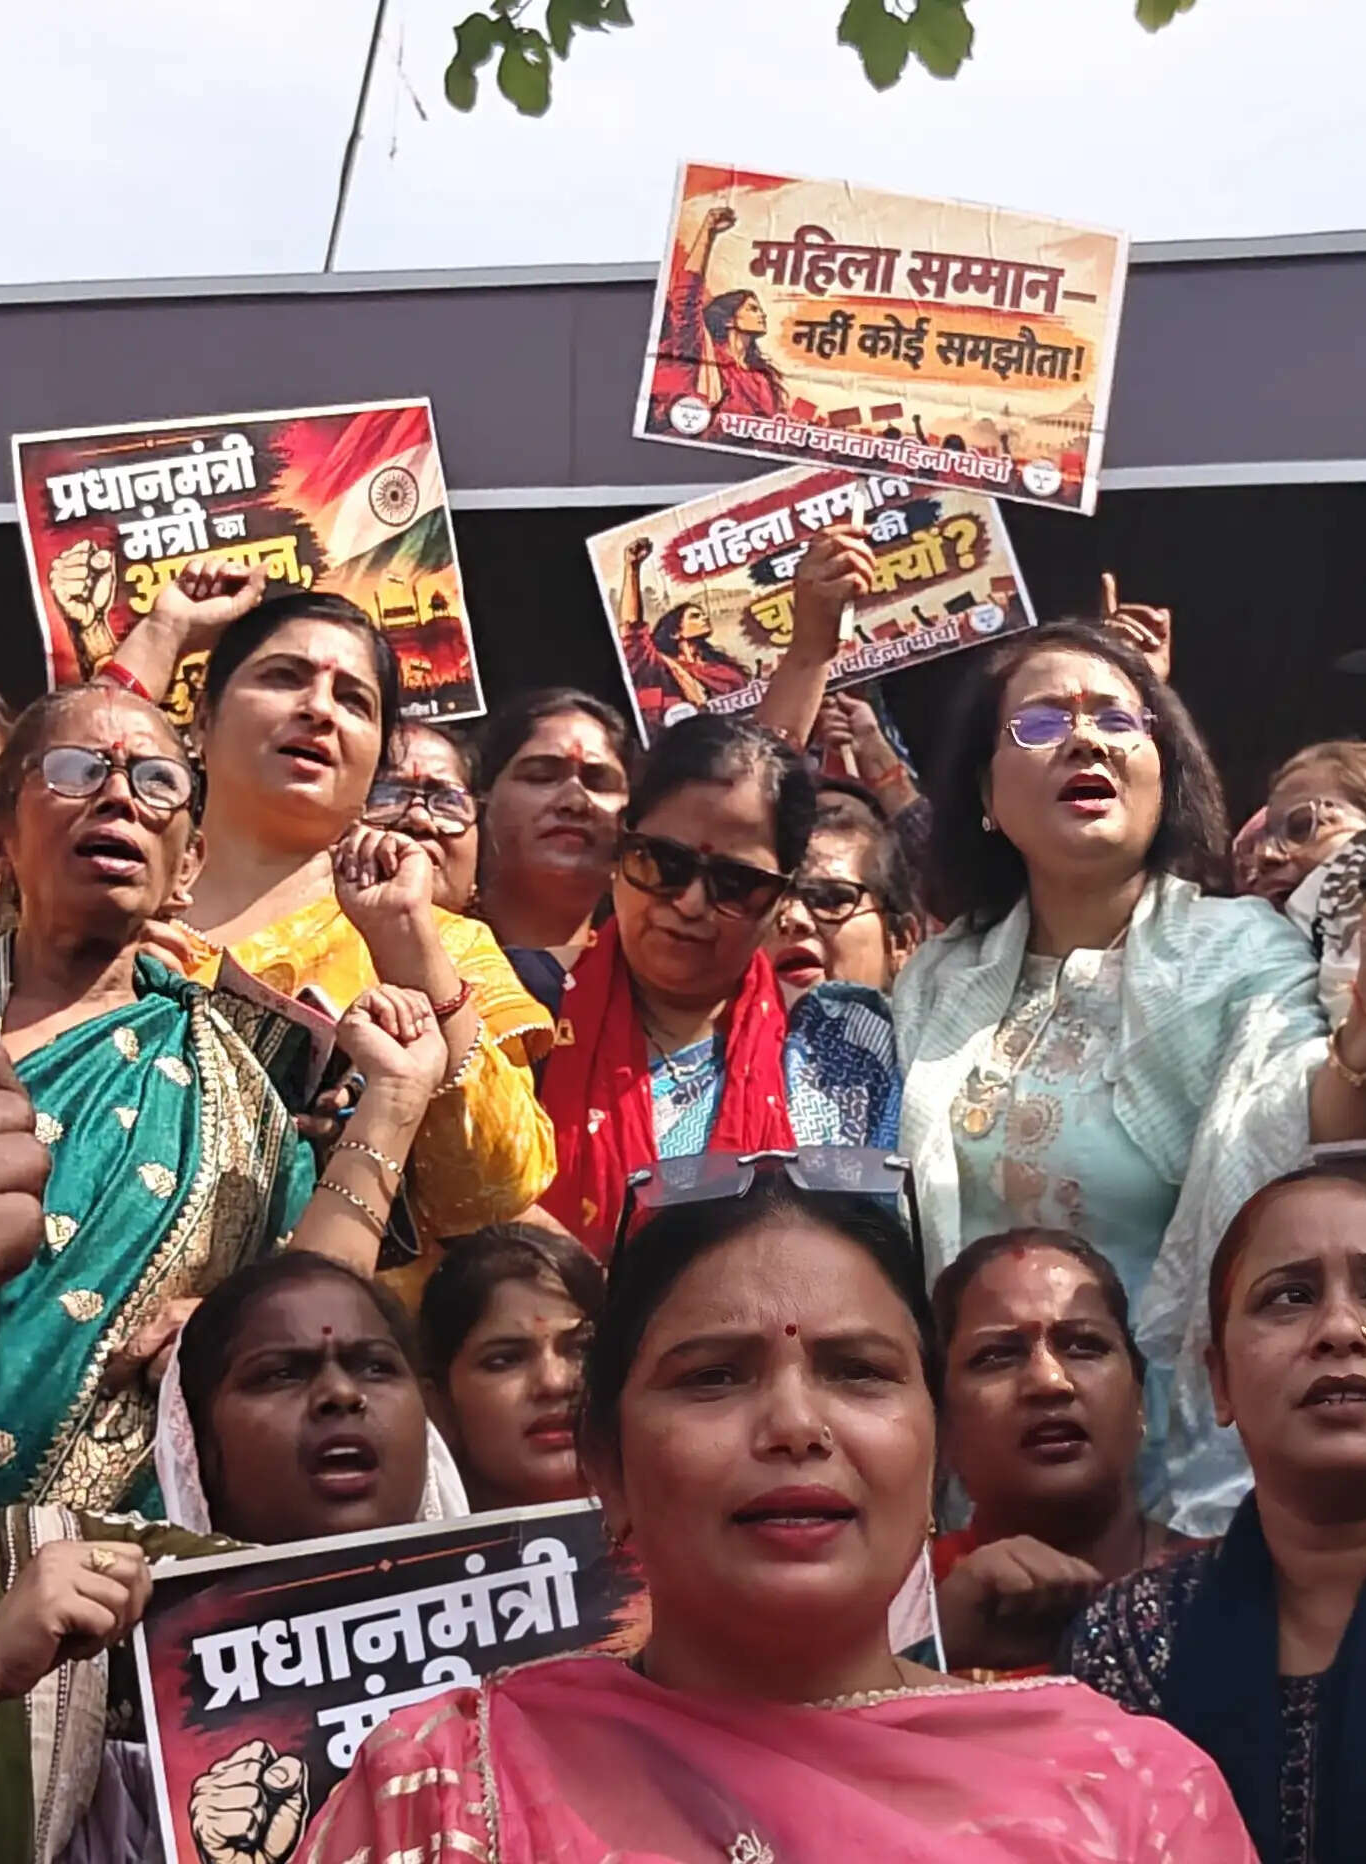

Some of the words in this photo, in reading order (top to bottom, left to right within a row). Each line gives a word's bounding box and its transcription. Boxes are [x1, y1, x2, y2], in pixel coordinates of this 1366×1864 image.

[748, 224, 900, 296] महिला
[791, 310, 854, 356] नहीं
[857, 314, 931, 371] कोई
[935, 325, 1085, 382] समझौता!
[46, 433, 257, 522] प्रधानमंत्री
[719, 412, 808, 448] भारतीय
[808, 426, 875, 461] जनता
[875, 437, 953, 474] महिला
[953, 449, 1014, 485] मोर्चा
[118, 499, 210, 560] मंत्री
[212, 515, 246, 539] का
[679, 508, 795, 574] महिला
[870, 511, 908, 542] की
[193, 1537, 579, 1711] प्रधानमंत्री
